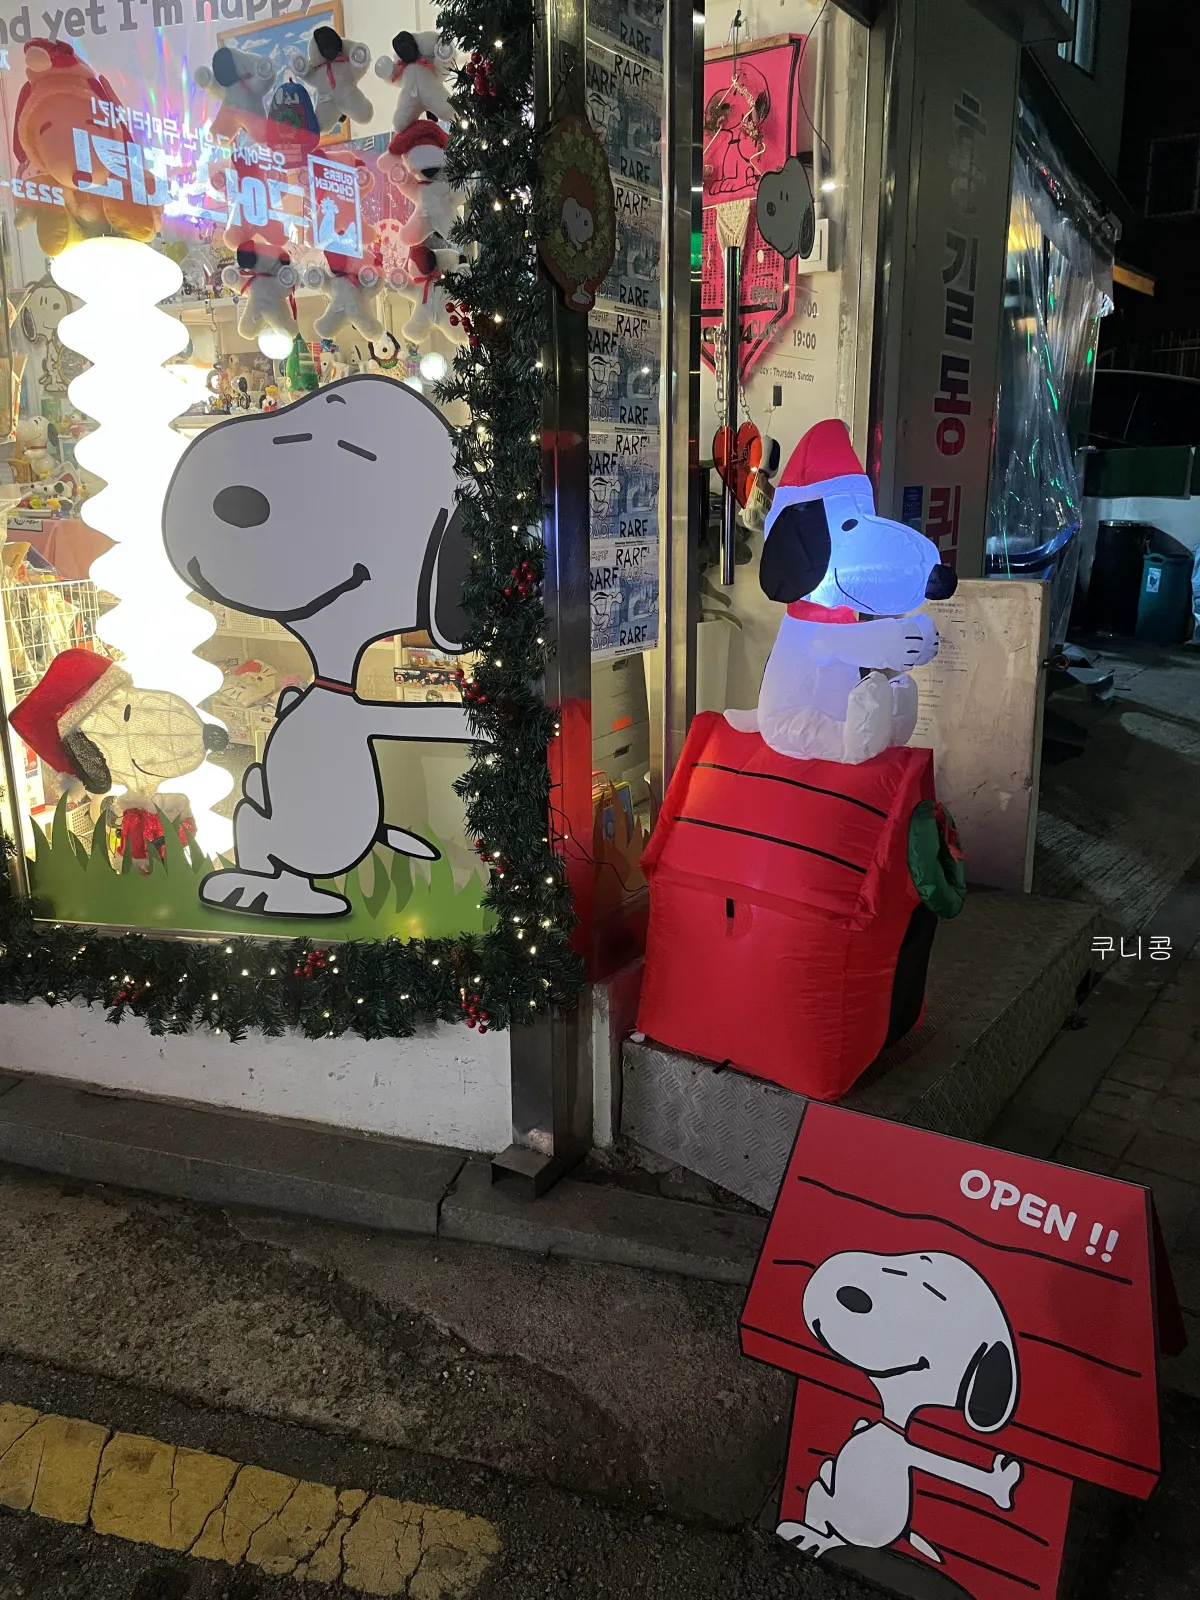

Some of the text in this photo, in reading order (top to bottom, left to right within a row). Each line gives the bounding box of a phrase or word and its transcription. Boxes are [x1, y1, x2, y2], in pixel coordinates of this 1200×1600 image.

[42, 0, 107, 44] yet
[196, 0, 312, 24] happ
[619, 284, 650, 308] RARF
[792, 329, 817, 350] 19:00
[798, 371, 815, 382] Sunday
[620, 405, 649, 424] RARF
[620, 518, 648, 538] RARF
[620, 625, 648, 647] RARF
[960, 1169, 1119, 1263] OPEN !!
